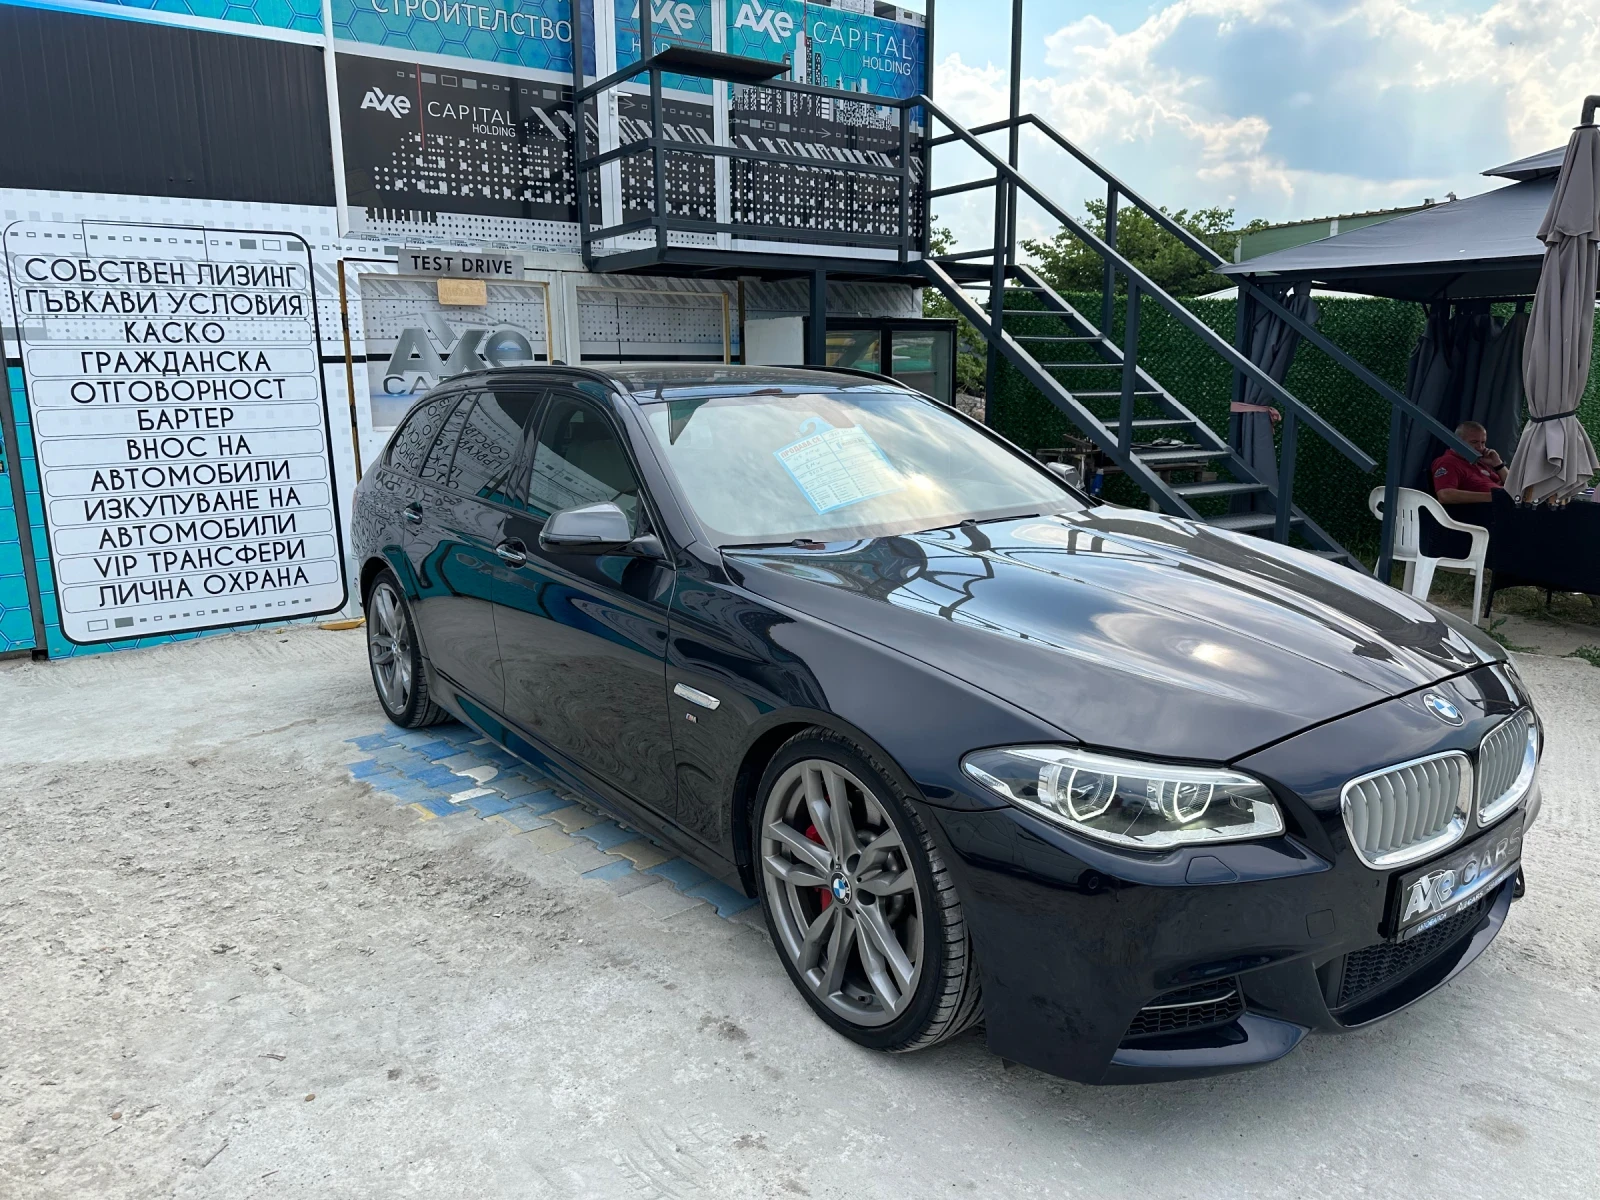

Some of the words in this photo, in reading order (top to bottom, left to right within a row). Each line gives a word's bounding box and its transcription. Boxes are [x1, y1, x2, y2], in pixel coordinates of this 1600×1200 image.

[813, 21, 912, 60] CAPITAL
[862, 57, 911, 76] HOLDING
[427, 101, 516, 126] CAPITAL
[472, 123, 516, 138] HOLDING
[24, 257, 186, 286] СОБСТВЕН
[196, 263, 297, 288] ЛИЗИНГ
[410, 255, 454, 273] TEST
[462, 257, 513, 275] DRIVE
[25, 289, 159, 315] ГЪВКАВИ
[170, 292, 303, 316] УСЛОВИЯ
[124, 320, 225, 344] КАСКО
[80, 350, 272, 377] ГРАЖДАНСКА
[70, 378, 286, 404] ОТГОВОРНОСТ
[137, 407, 234, 431] БАРТЕР
[126, 436, 208, 461] ВНОС
[218, 434, 252, 456] НА
[780, 440, 812, 459] ПРОДАВА
[812, 435, 822, 443] СЕ
[90, 459, 291, 492] АВТОМОБИЛИ
[84, 488, 260, 522] ИЗКУПУВАНЕ
[268, 486, 301, 508] НА
[98, 512, 297, 550] АВТОМОБИЛИ
[93, 554, 138, 578] VIP
[147, 538, 306, 574] ТРАНСФЕРИ
[99, 577, 193, 608] ЛИЧНА
[203, 564, 310, 595] ОХРАНА
[1461, 826, 1521, 886] CARS
